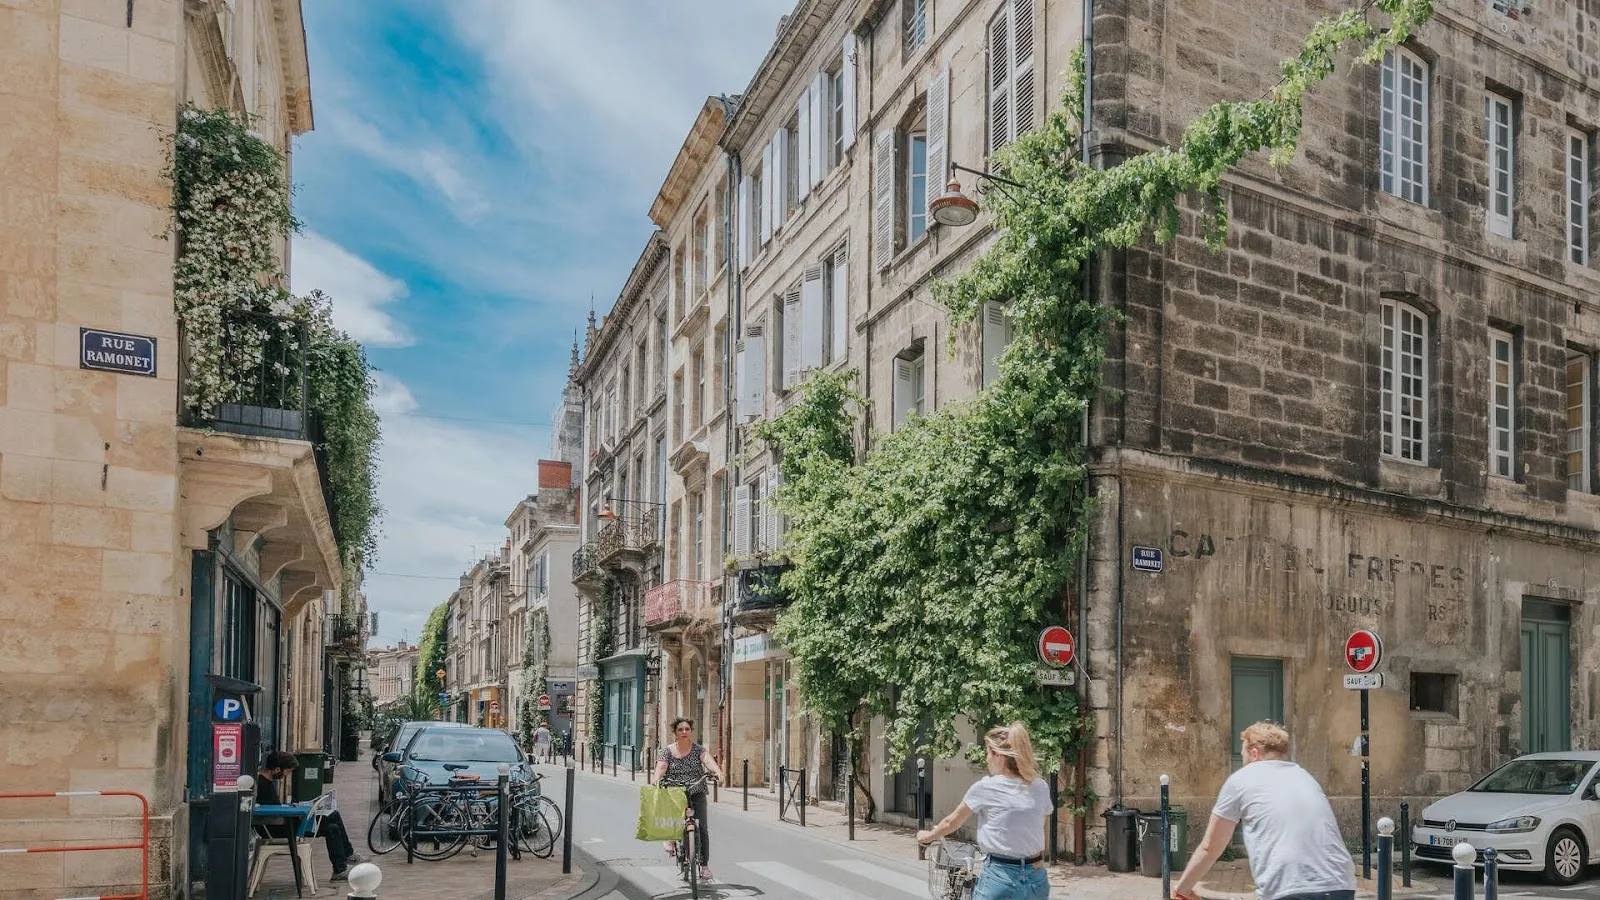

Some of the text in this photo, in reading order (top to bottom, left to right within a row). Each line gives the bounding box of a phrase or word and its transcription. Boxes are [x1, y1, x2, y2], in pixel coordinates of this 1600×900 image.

[101, 336, 135, 351] RUE
[86, 350, 151, 368] RAMONET
[1141, 550, 1156, 558] RUE
[1134, 558, 1161, 568] RAMONET
[1040, 673, 1057, 681] SAUF
[223, 699, 240, 719] P
